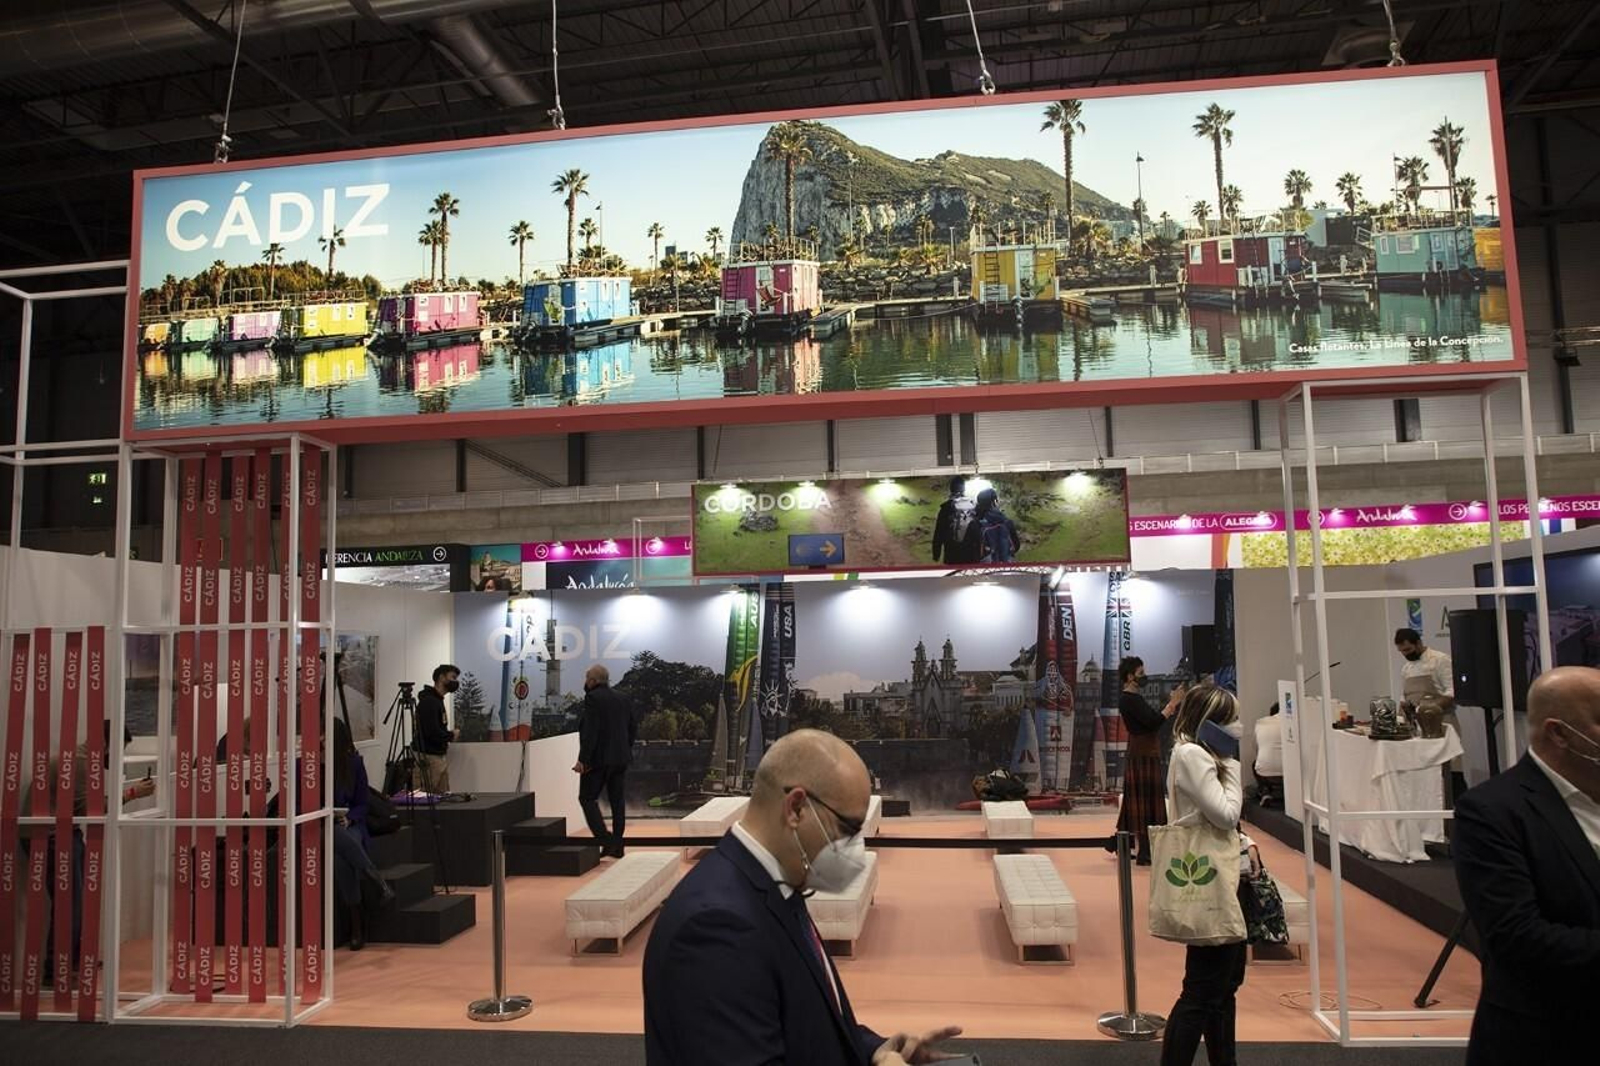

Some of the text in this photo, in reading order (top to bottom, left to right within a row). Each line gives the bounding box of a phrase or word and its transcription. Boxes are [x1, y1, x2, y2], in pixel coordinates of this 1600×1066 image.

[166, 181, 390, 251] CÁDIZ
[1289, 343, 1317, 353] Casas
[1414, 337, 1427, 347] de
[1428, 336, 1438, 347] la
[185, 476, 196, 512] CÁDIZ
[206, 479, 217, 514] CÁDIZ
[234, 476, 244, 512] CÁDIZ
[256, 473, 266, 509] CÁDIZ
[306, 470, 316, 506] CÁDIZ
[1192, 518, 1205, 529] DE
[1206, 517, 1219, 528] LA
[1498, 504, 1517, 514] LOS
[1572, 500, 1600, 511] ESCE
[326, 552, 372, 564] ERENCIA
[183, 566, 193, 602] CÁDIZ
[204, 570, 214, 606] CÁDIZ
[232, 567, 242, 603] CÁDIZ
[254, 565, 264, 601] CÁDIZ
[305, 563, 316, 599] CÁDIZ
[750, 591, 760, 628] AUS
[783, 605, 792, 638] USA
[1061, 607, 1074, 641] DEN
[1123, 620, 1131, 651] GBR
[13, 654, 25, 692] CÁDIZ
[37, 654, 47, 691] CÁDIZ
[66, 651, 78, 690] CÁDIZ
[90, 652, 101, 690] CÁDIZ
[181, 658, 191, 695] CÁDIZ
[202, 662, 212, 699] CÁDIZ
[230, 660, 241, 696] CÁDIZ
[253, 659, 264, 695] CÁDIZ
[305, 656, 316, 693] CÁDIZ
[6, 752, 18, 791] CÁDIZ
[35, 752, 46, 790] CÁDIZ
[61, 751, 72, 789] CÁDIZ
[90, 751, 101, 790] CÁDIZ
[179, 752, 189, 788] CÁDIZ
[201, 756, 212, 792] CÁDIZ
[230, 754, 240, 791] CÁDIZ
[253, 752, 263, 790] CÁDIZ
[305, 751, 316, 789] CÁDIZ
[2, 852, 13, 891] CÁDIZ
[31, 851, 44, 891] CÁDIZ
[58, 851, 68, 890] CÁDIZ
[87, 852, 98, 891] CÁDIZ
[178, 846, 188, 883] CÁDIZ
[200, 850, 211, 888] CÁDIZ
[229, 849, 239, 886] CÁDIZ
[252, 849, 263, 886] CÁDIZ
[305, 848, 317, 885] CÁDIZ
[1, 954, 10, 994] CÁDIZ
[26, 955, 37, 995] CÁDIZ
[58, 954, 68, 994] CÁDIZ
[82, 955, 94, 996] CÁDIZ
[177, 942, 187, 979] CÁDIZ
[199, 947, 210, 986] CÁDIZ
[228, 945, 238, 983] CÁDIZ
[252, 947, 263, 984] CÁDIZ
[307, 945, 317, 982] CÁDIZ
